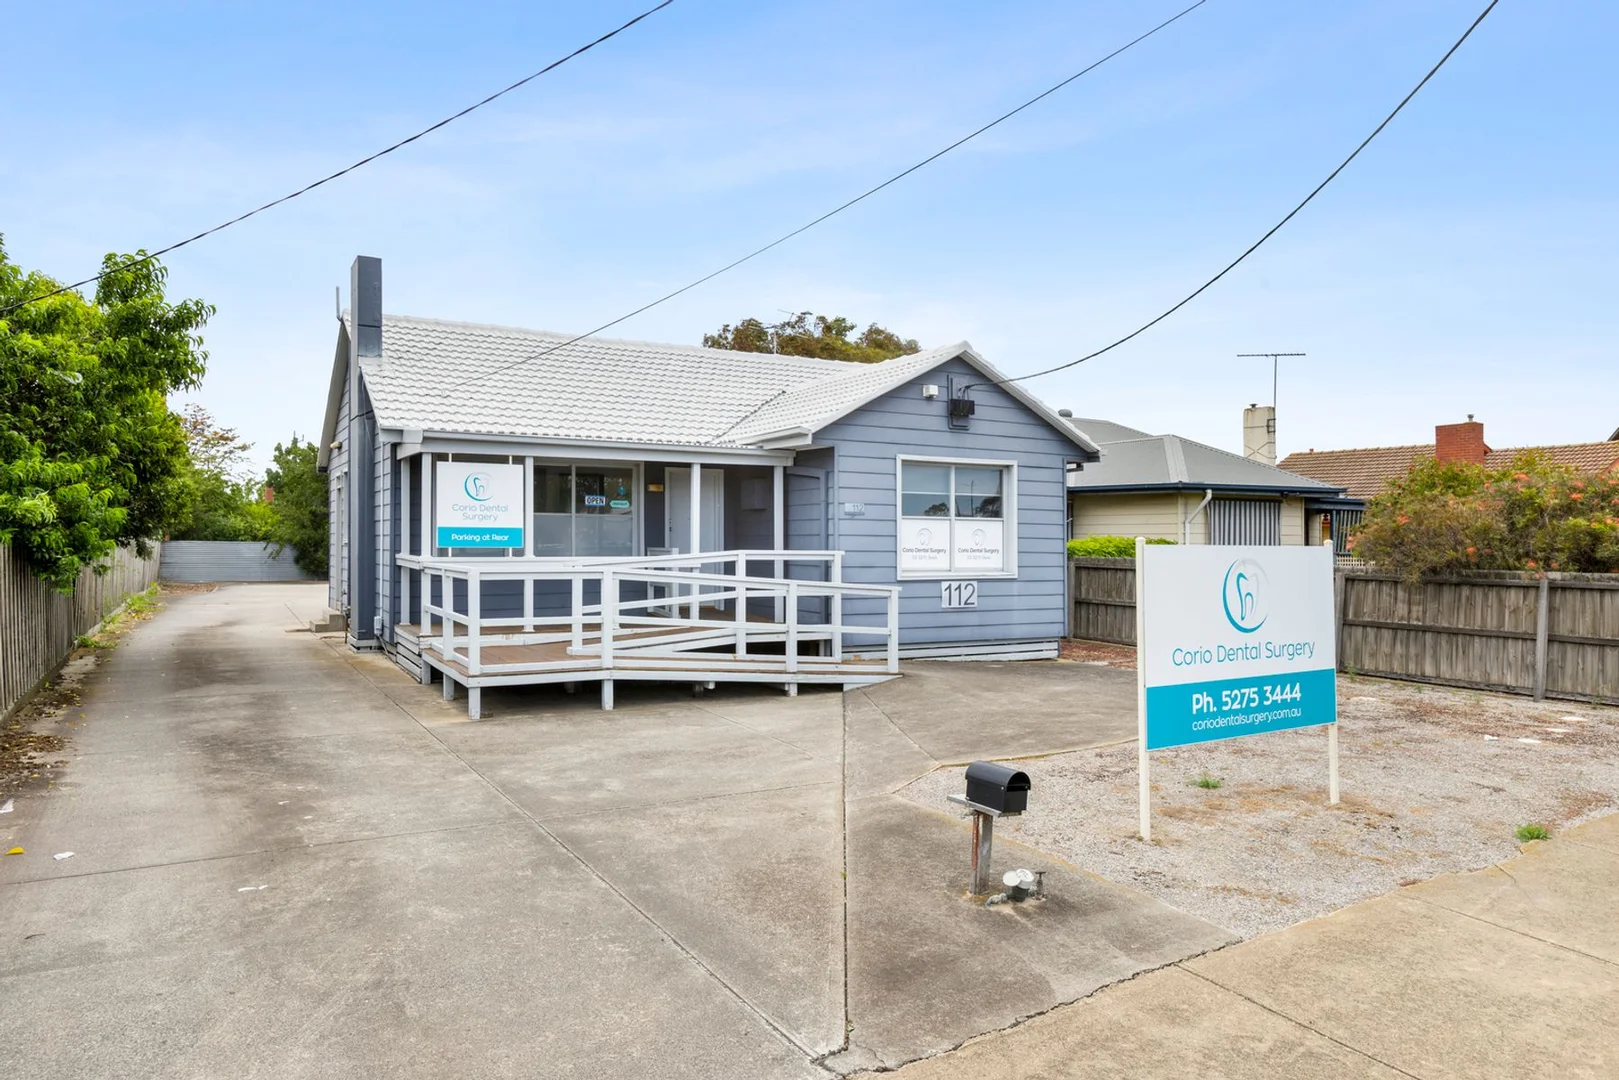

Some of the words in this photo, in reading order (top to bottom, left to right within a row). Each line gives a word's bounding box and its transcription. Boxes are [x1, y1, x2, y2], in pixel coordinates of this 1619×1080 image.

[452, 503, 477, 513] Corio
[479, 503, 509, 513] Dental
[586, 496, 604, 505] OPEN
[462, 512, 498, 522] Surgery
[451, 533, 481, 543] Parking
[482, 534, 490, 542] at
[491, 533, 509, 542] Rear
[943, 582, 976, 606] 112
[1172, 645, 1213, 667] Corio
[1217, 642, 1262, 663] Dental
[1265, 640, 1315, 661] Surgery
[1192, 690, 1217, 714] Ph.
[1221, 687, 1259, 711] 5275
[1263, 682, 1302, 705] 3444
[1192, 706, 1302, 731] coriodentalsurgery.com.au
